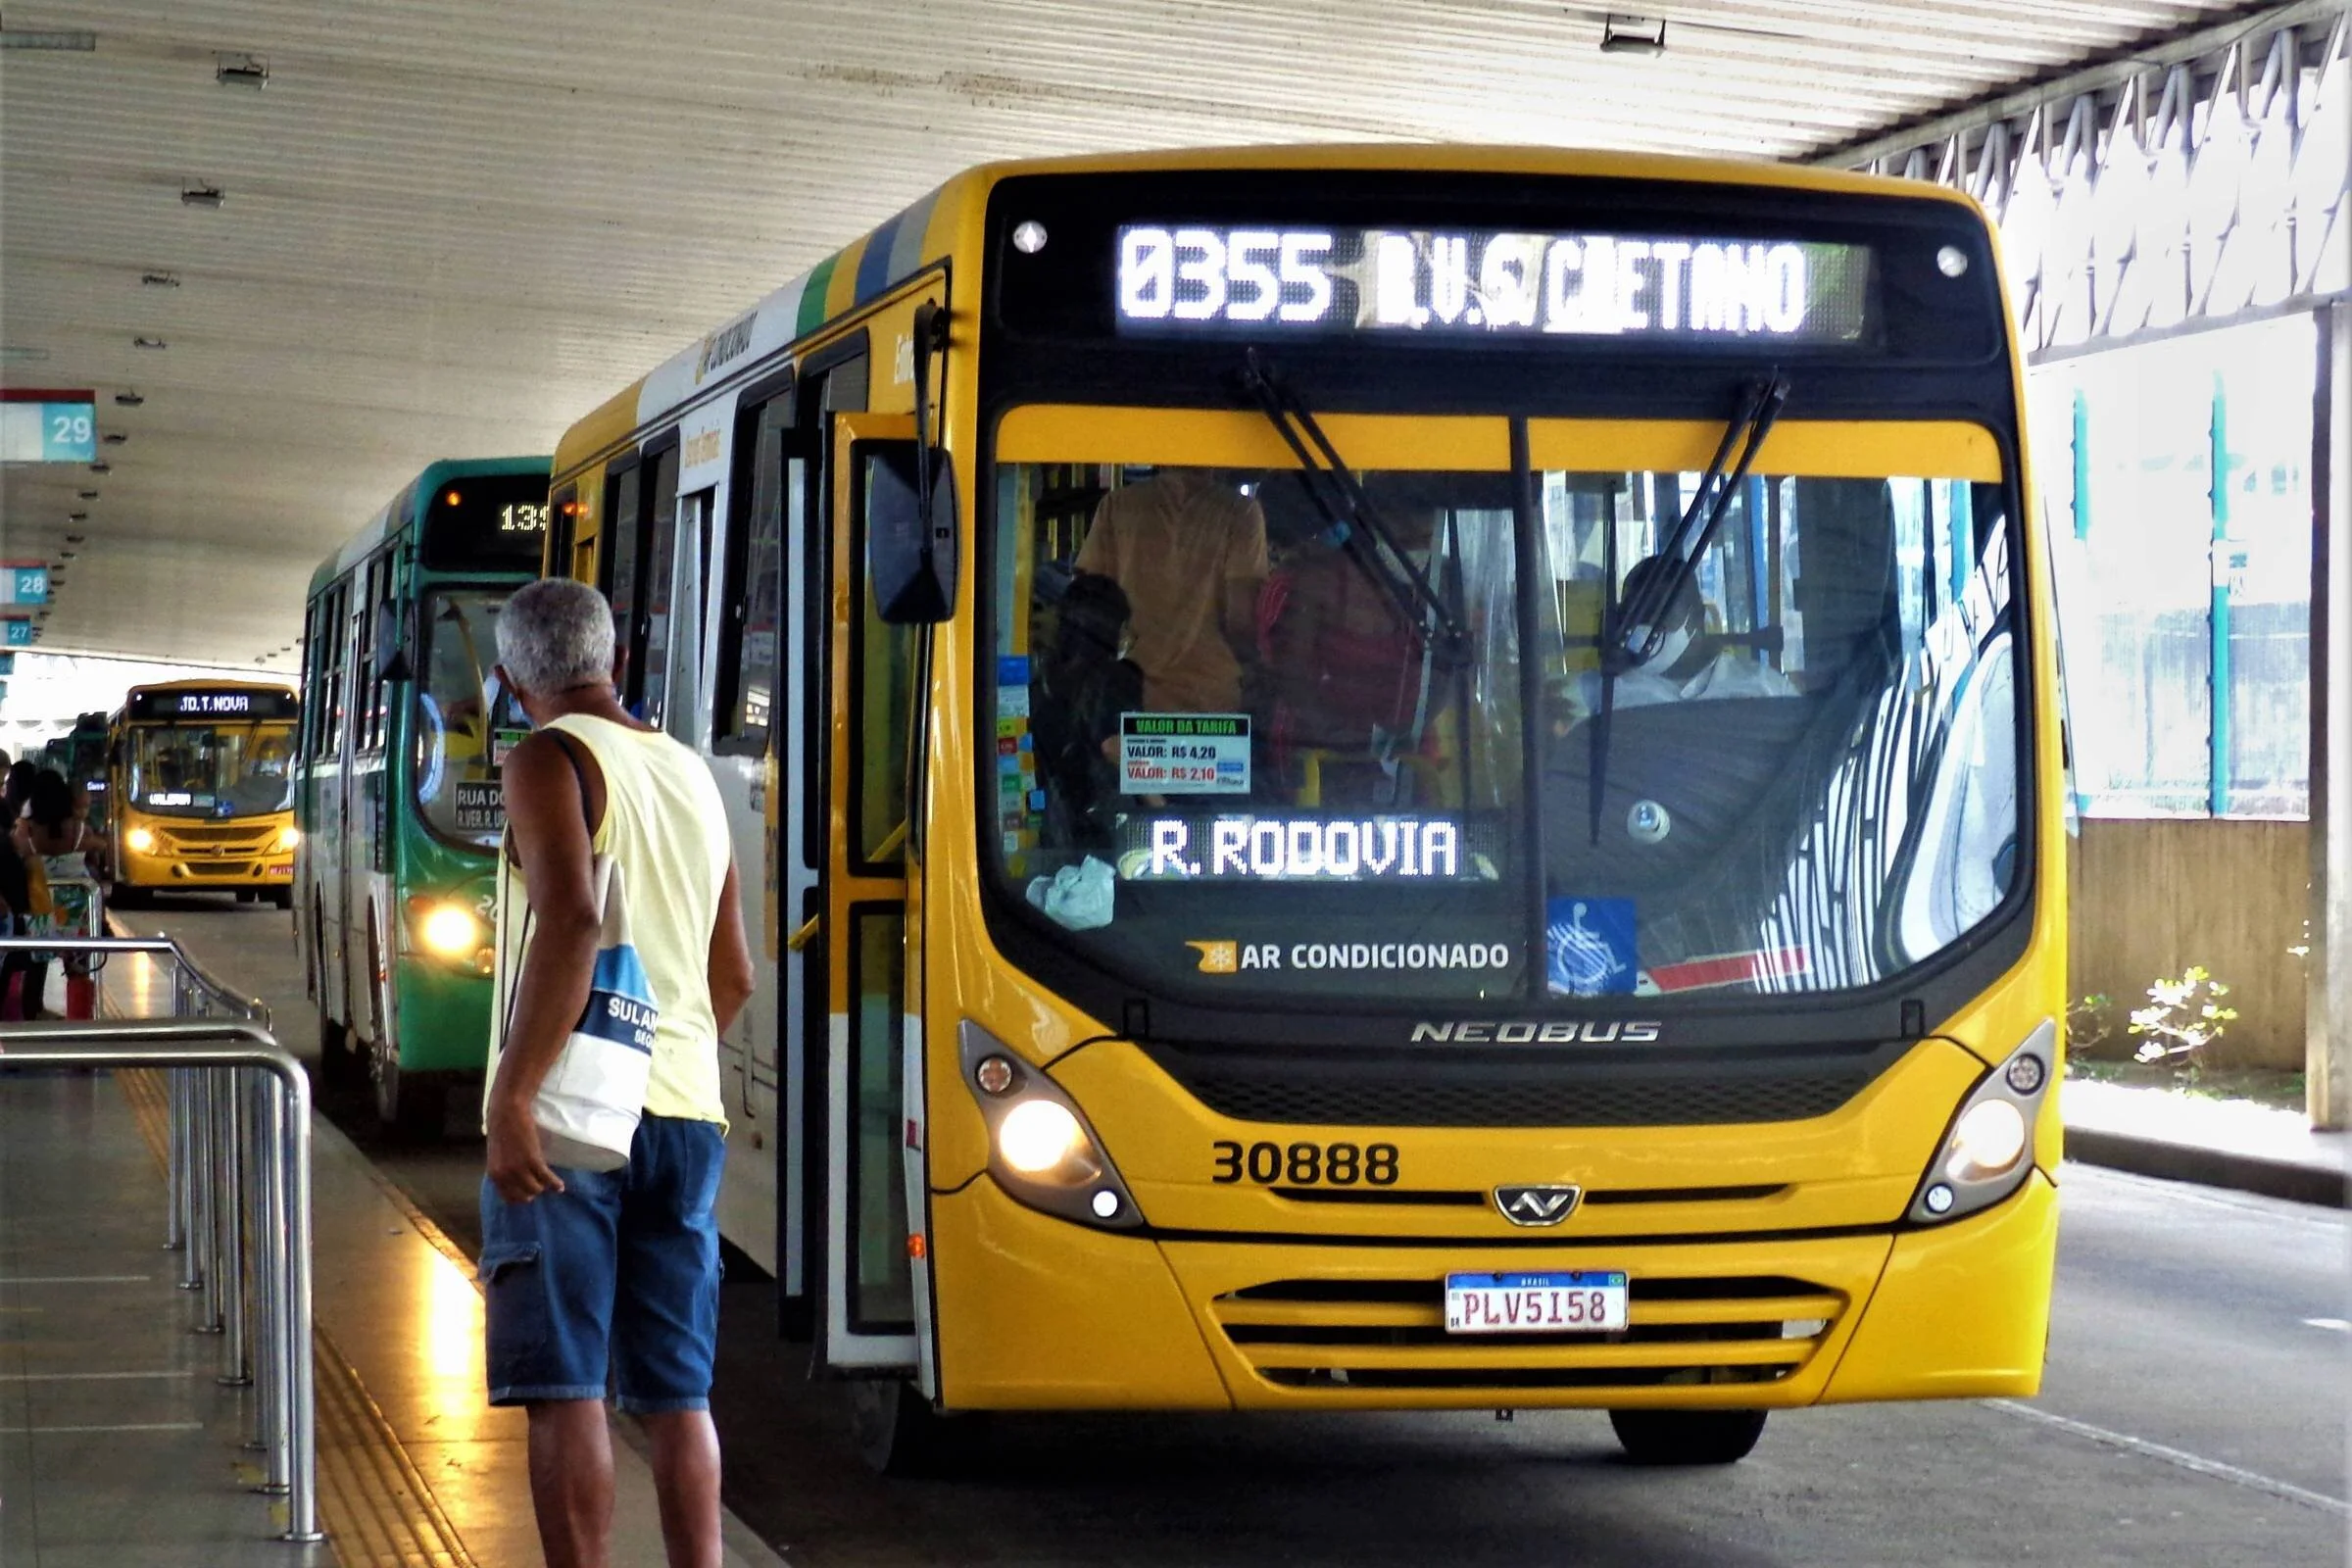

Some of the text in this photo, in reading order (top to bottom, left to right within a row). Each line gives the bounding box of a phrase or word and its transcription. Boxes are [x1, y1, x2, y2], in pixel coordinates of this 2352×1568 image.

[1120, 227, 1332, 321] 0355
[53, 416, 91, 443] 29
[21, 575, 44, 593] 28
[11, 626, 27, 638] 27
[1137, 719, 1236, 735] VALOR DA TARIFA
[1127, 745, 1216, 760] VALOR: R$ 4,20
[1127, 767, 1167, 779] VALOR:
[1172, 767, 1187, 779] R$
[1191, 767, 1214, 781] 2,10
[458, 789, 487, 806] RUA
[1213, 820, 1457, 876] RODOVIA
[1241, 943, 1509, 969] AR CONDICIONADO
[1410, 1021, 1662, 1043] NEOBUS
[1212, 1141, 1399, 1185] 30888
[1520, 1278, 1550, 1288] BRASIL
